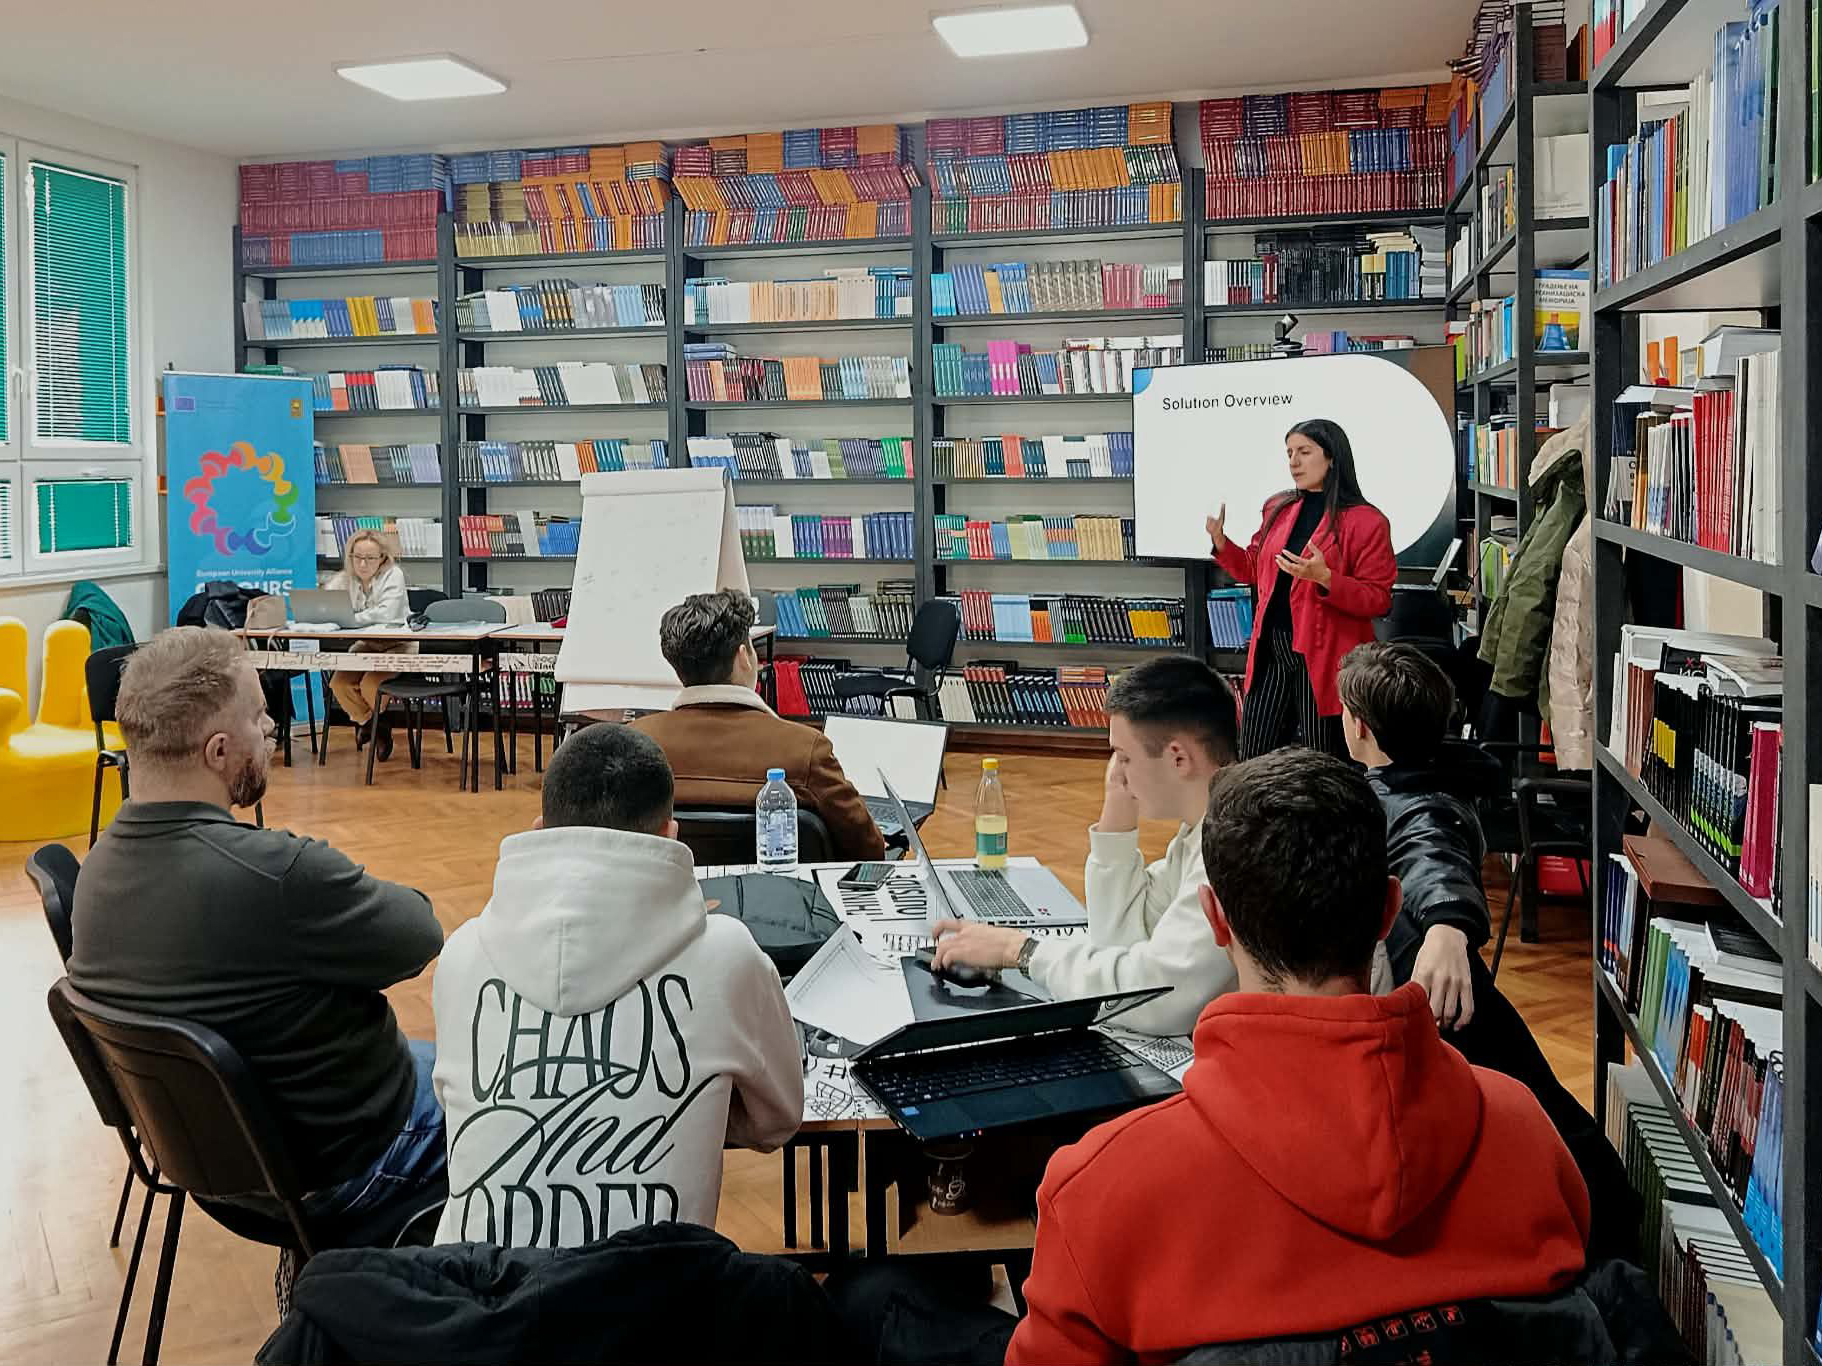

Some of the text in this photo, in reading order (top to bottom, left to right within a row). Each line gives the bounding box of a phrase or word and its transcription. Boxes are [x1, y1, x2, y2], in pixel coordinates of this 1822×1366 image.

[1162, 394, 1293, 410] Solution Overview
[196, 568, 292, 578] European University Alliance
[471, 974, 693, 1102] CHAOS
[449, 1056, 722, 1198] And
